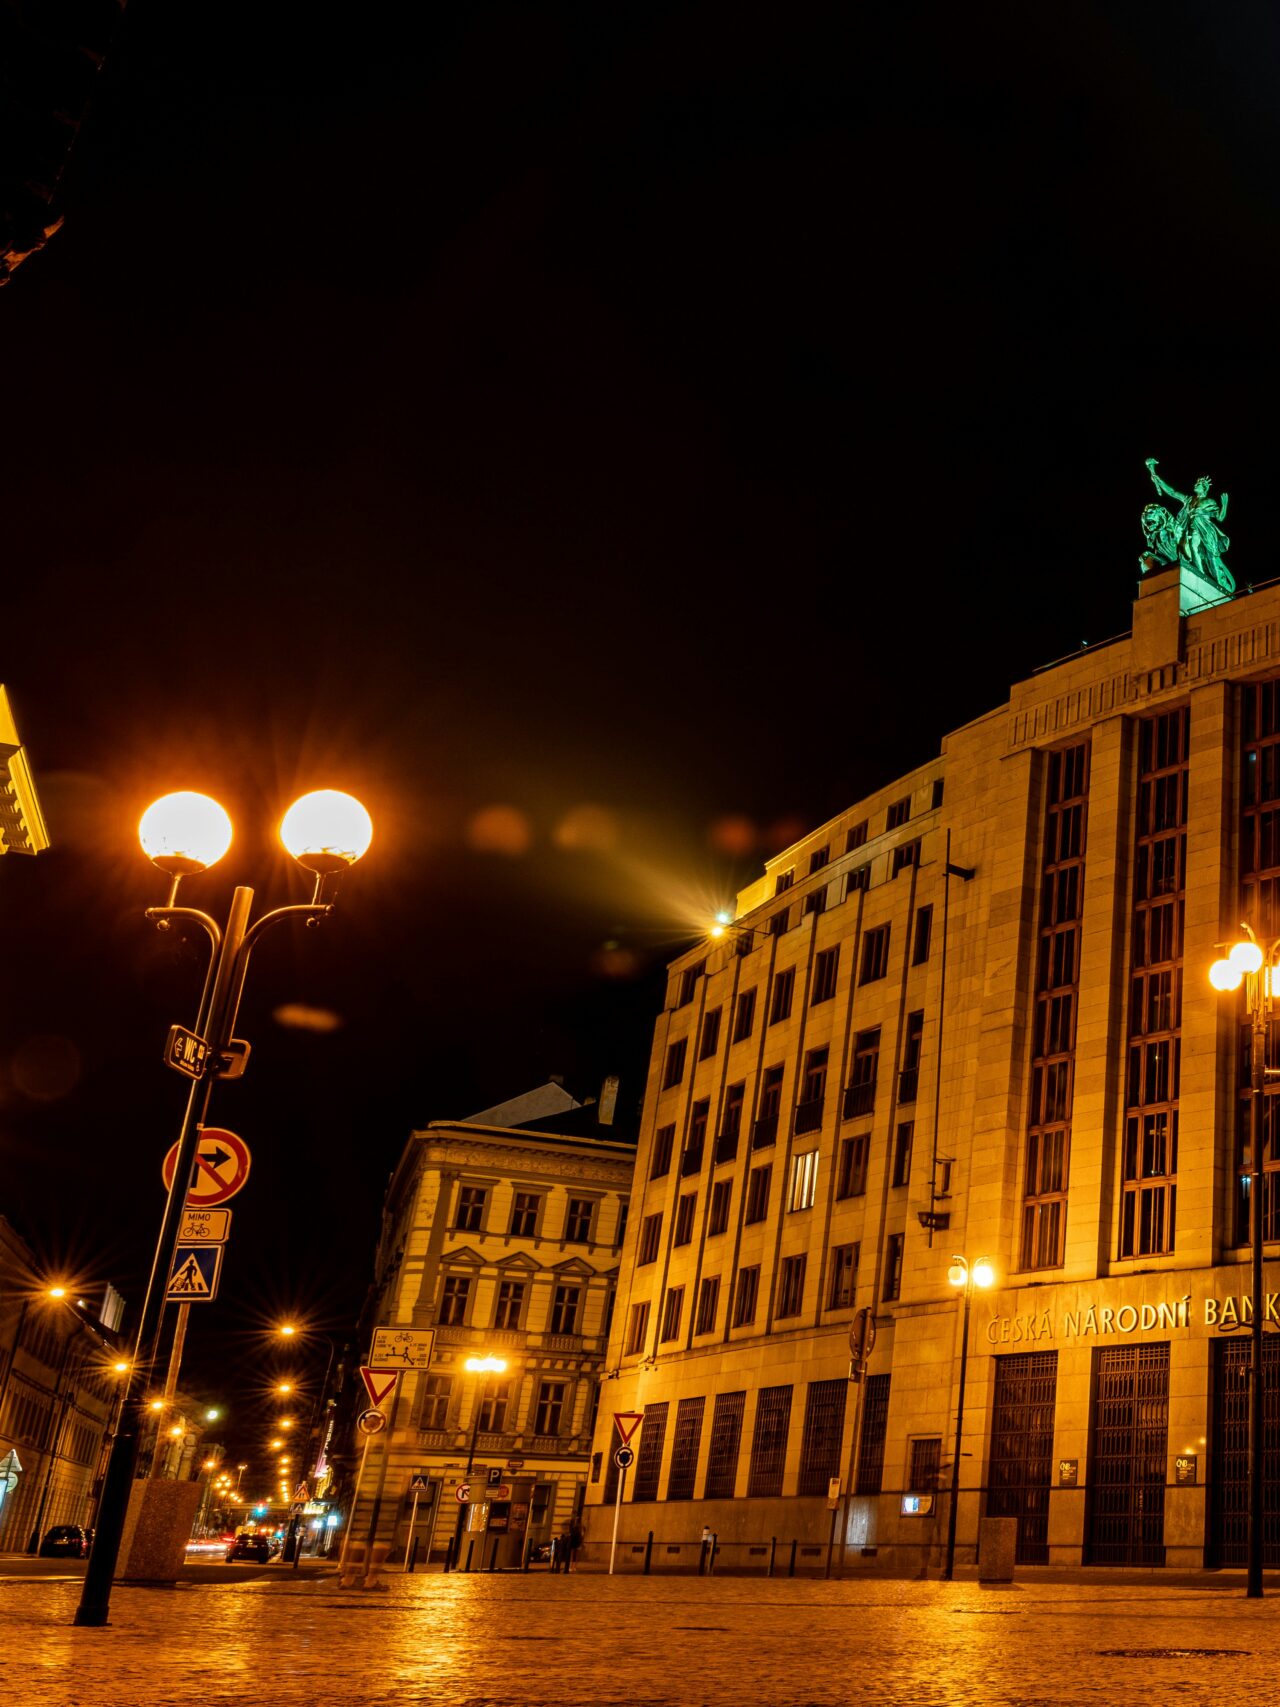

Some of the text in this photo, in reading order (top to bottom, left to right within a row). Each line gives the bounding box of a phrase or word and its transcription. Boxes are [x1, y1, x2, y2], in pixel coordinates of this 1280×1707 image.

[187, 1213, 211, 1222] MIMO
[986, 1308, 1054, 1345] ČESKÁ
[1064, 1295, 1192, 1338] NÁRODNÍ
[489, 1469, 500, 1483] P
